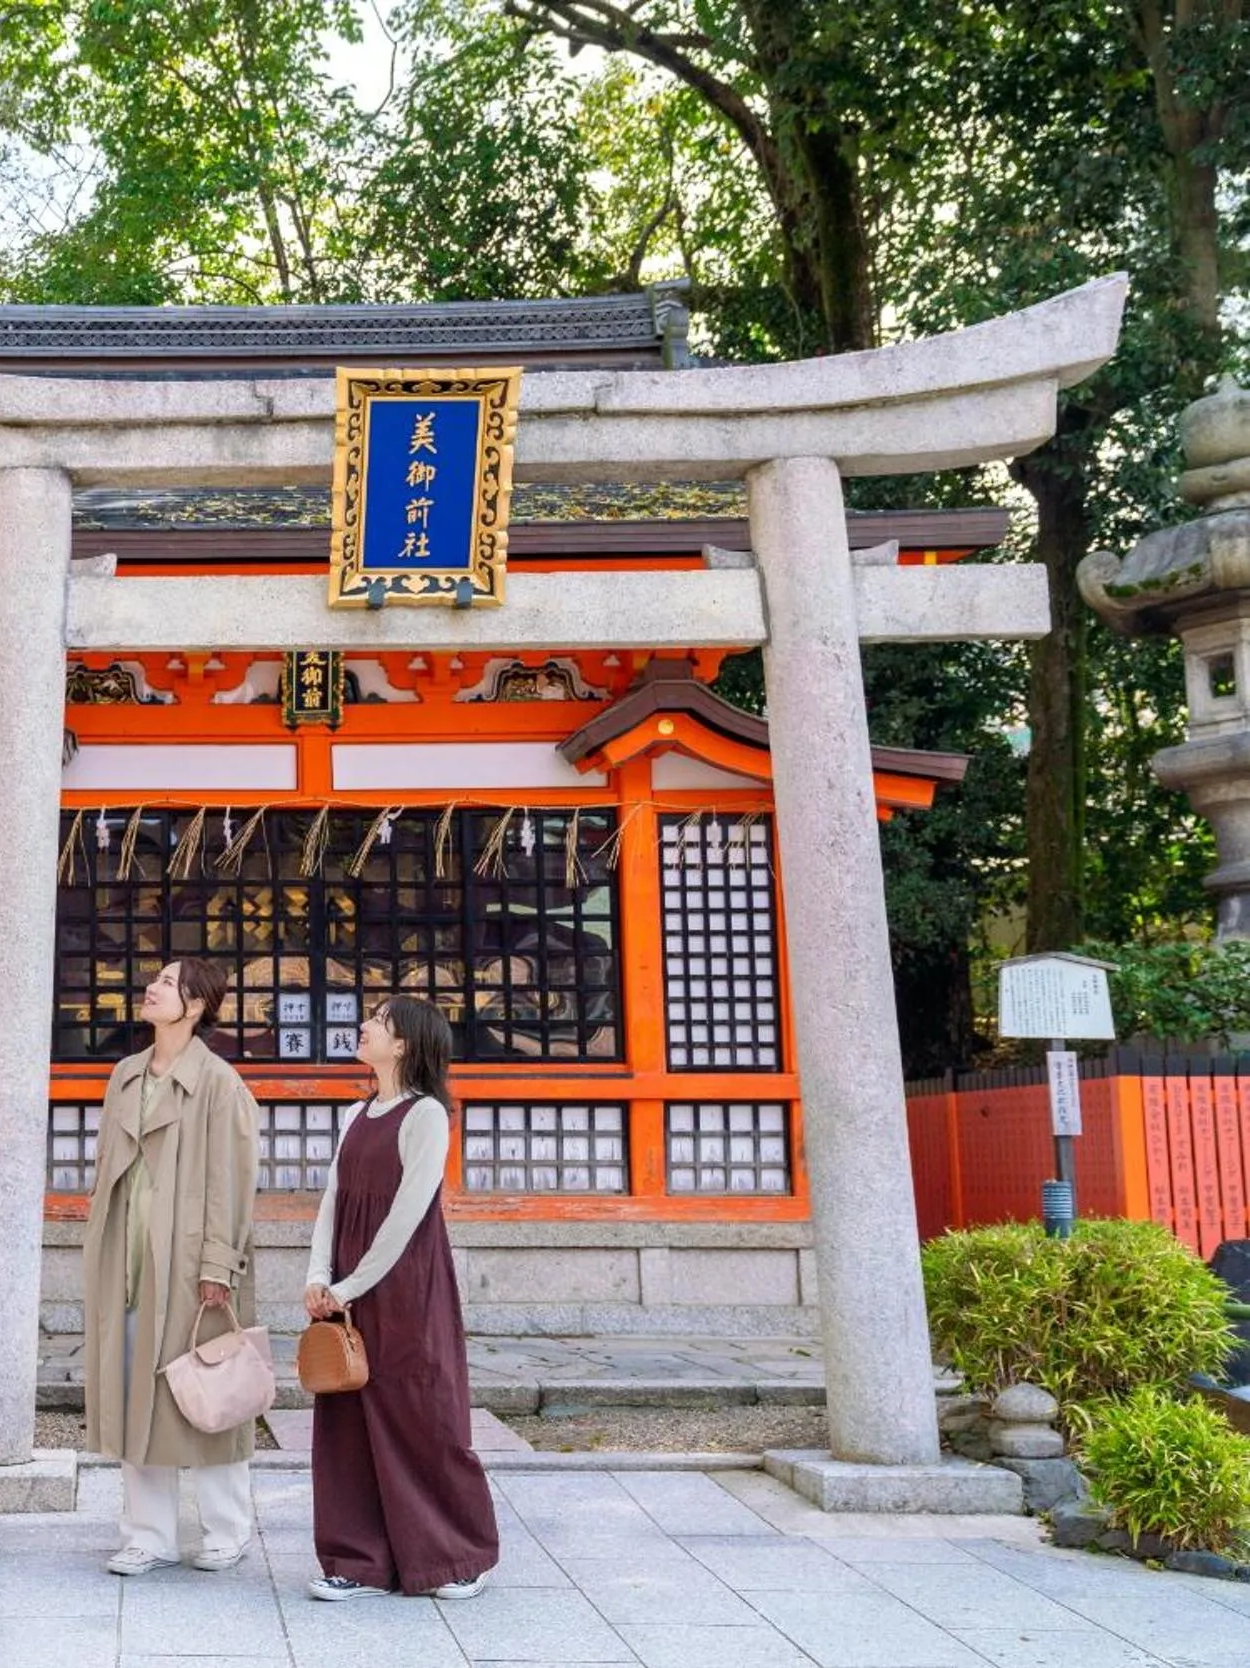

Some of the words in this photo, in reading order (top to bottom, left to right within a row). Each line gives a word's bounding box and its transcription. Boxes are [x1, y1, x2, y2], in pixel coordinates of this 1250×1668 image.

[397, 411, 438, 559] 美御前社
[333, 1031, 352, 1052] 銭
